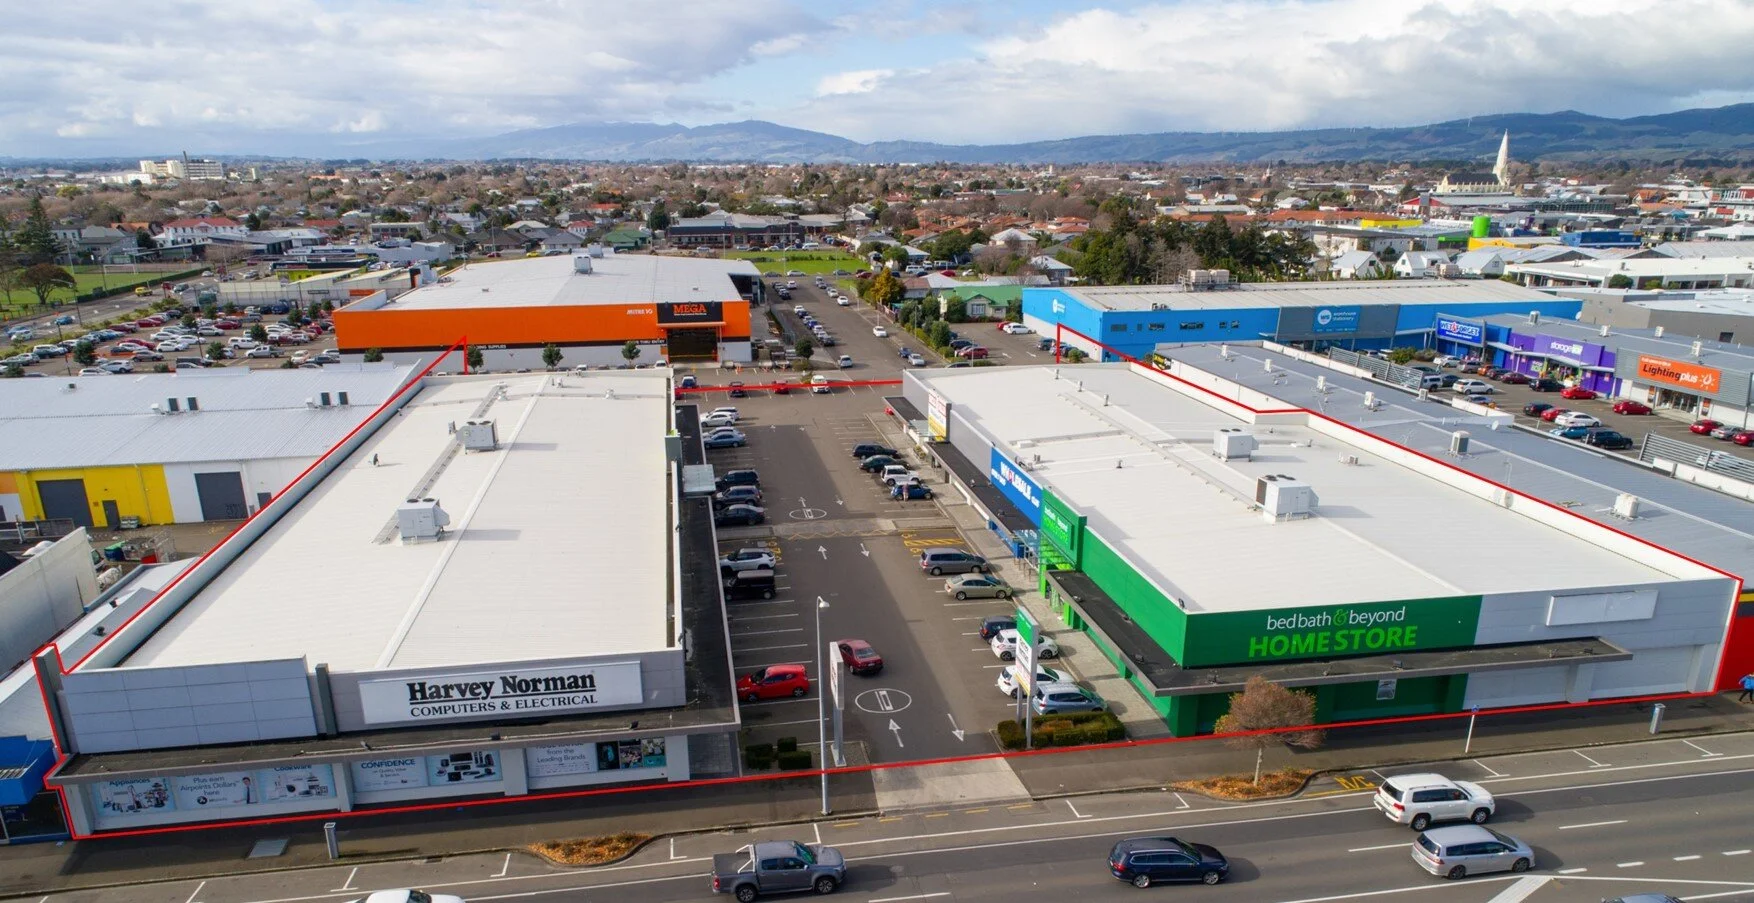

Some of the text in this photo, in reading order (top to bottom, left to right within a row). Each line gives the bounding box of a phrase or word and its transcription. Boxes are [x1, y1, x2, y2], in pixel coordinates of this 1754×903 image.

[673, 304, 706, 313] MEGA
[1267, 606, 1406, 630] bed bath & beyond
[1248, 625, 1418, 658] HOME STORE
[406, 673, 596, 700] Harvey Norman
[410, 694, 598, 717] COMPUTERS & ELECTRICAL
[563, 753, 586, 761] Brands
[361, 758, 416, 769] CONFIDENCE
[193, 776, 208, 784] Plus
[180, 783, 212, 792] Airpoints
